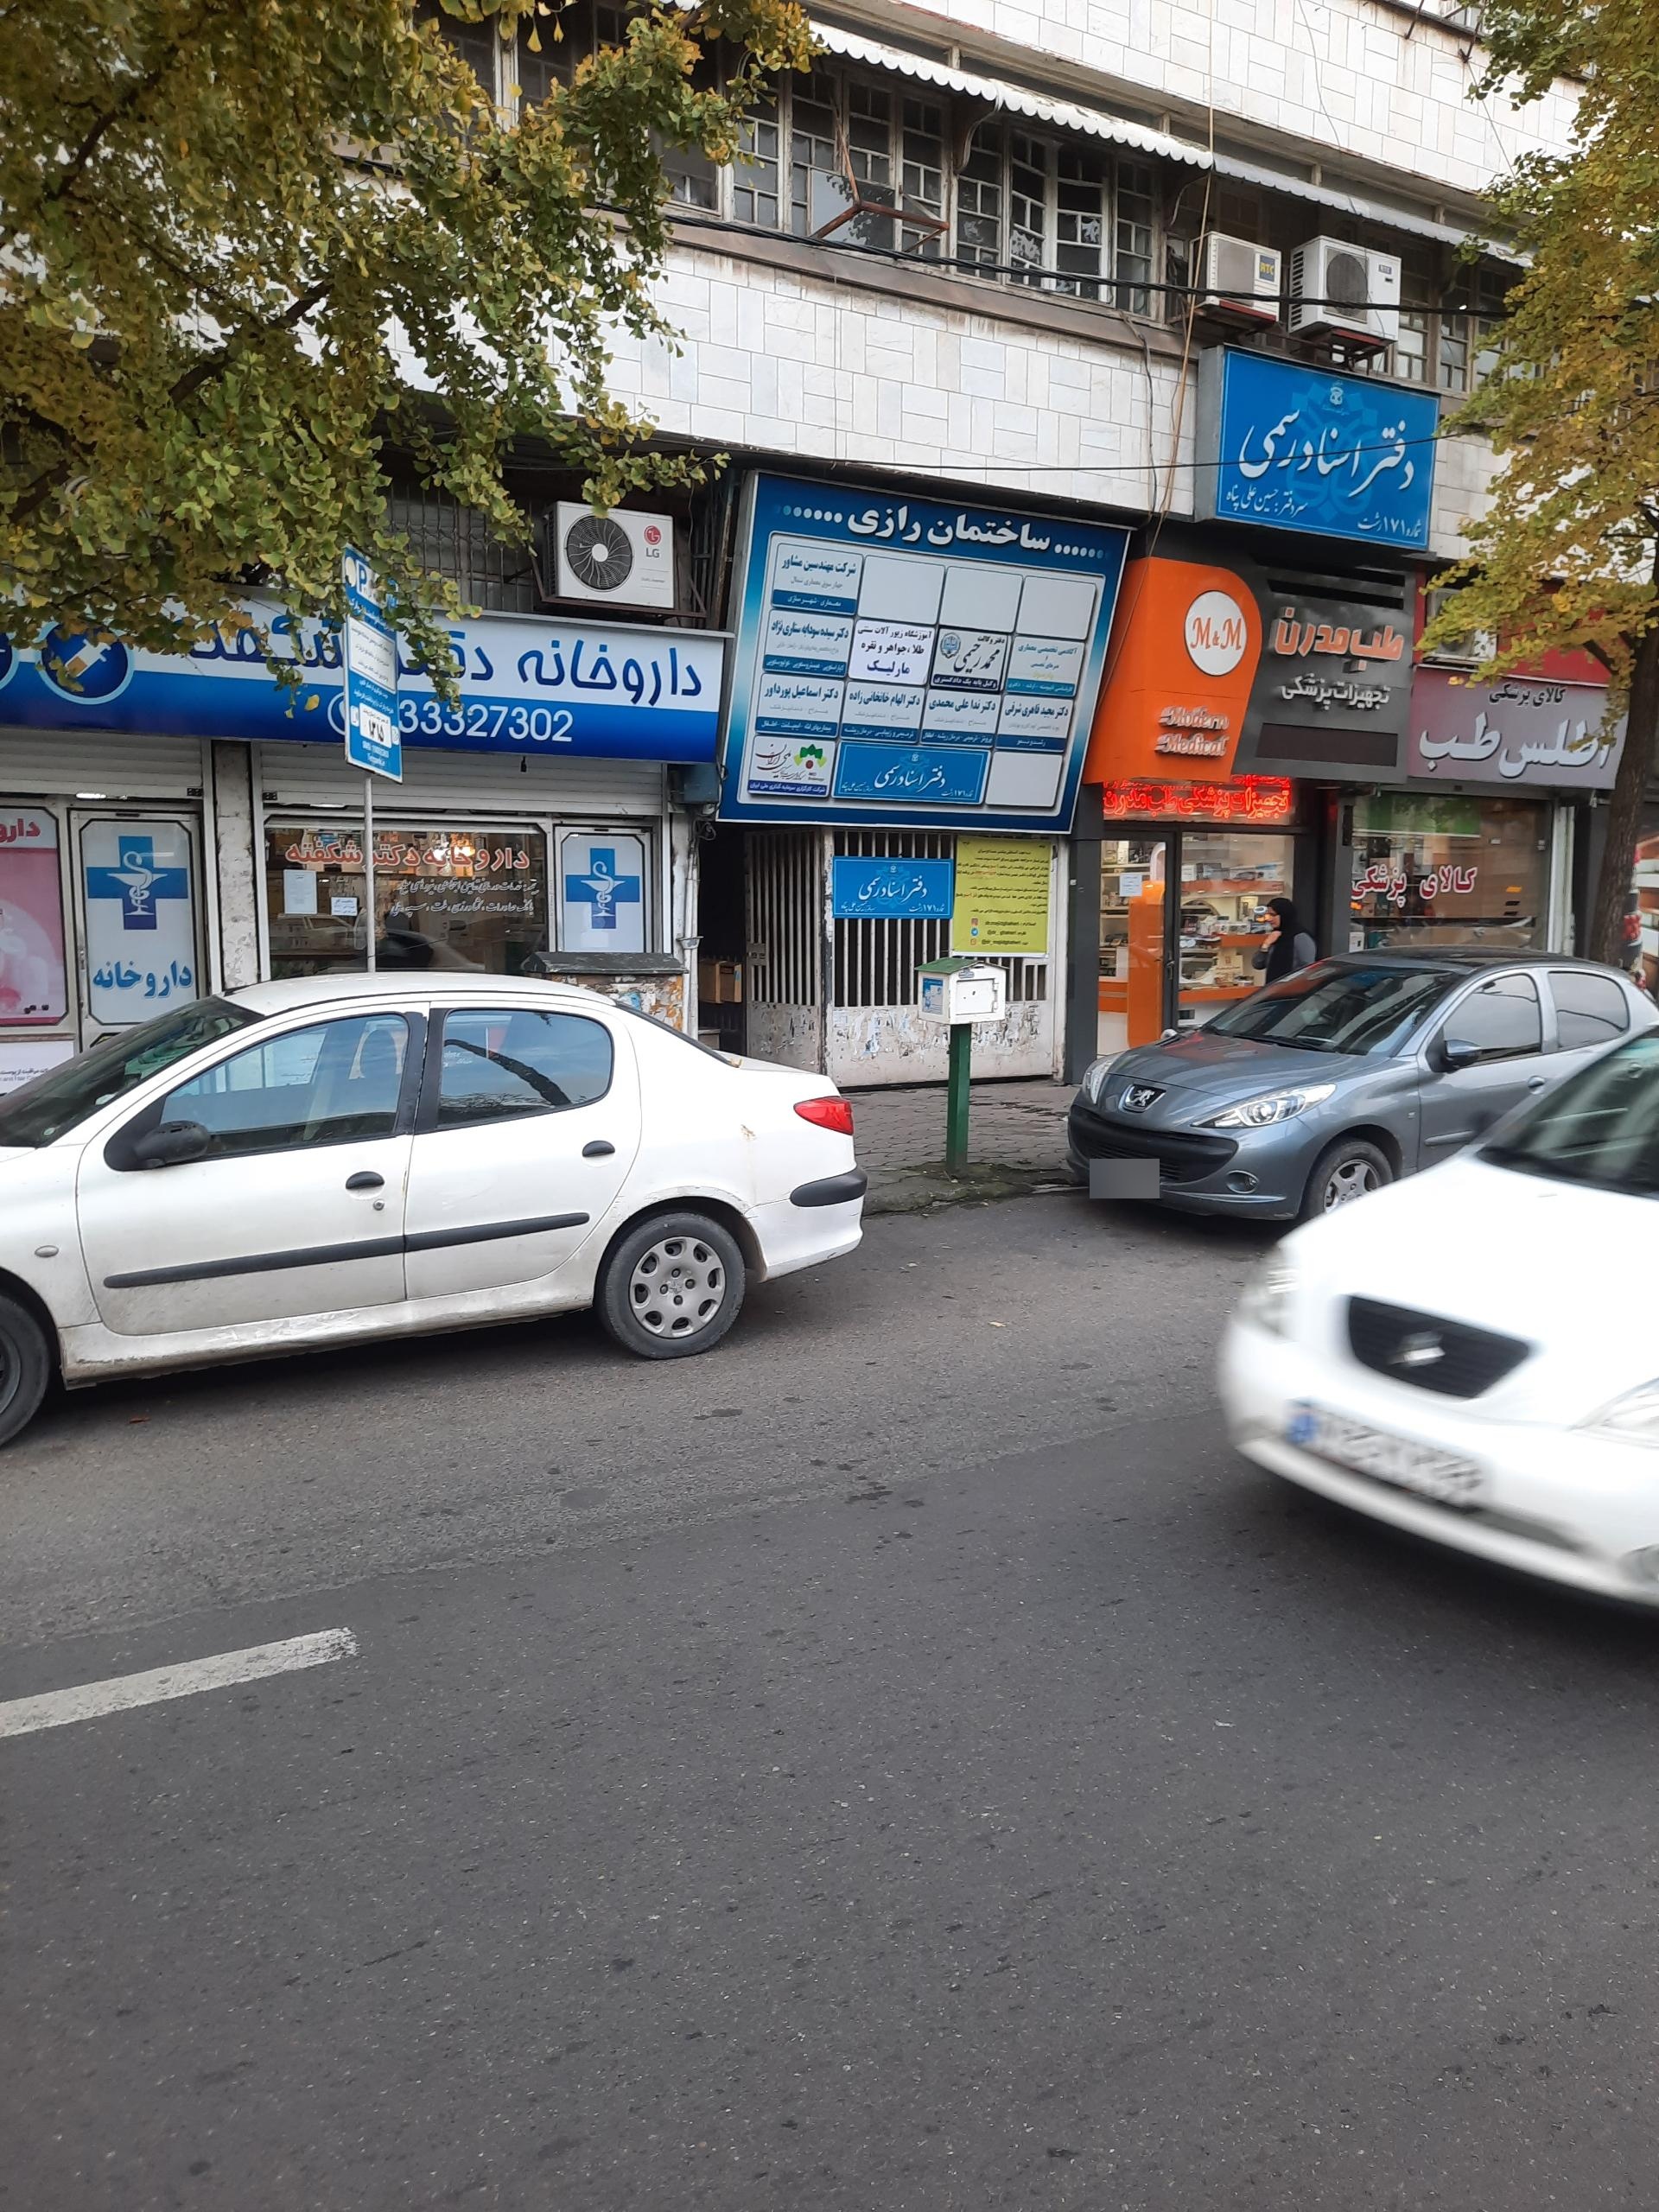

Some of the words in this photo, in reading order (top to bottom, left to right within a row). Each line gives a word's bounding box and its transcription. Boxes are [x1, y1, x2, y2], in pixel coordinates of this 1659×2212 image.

[1239, 409, 1300, 478] رسمی
[1298, 427, 1362, 479] اسناد
[1349, 420, 1414, 497] دفتر
[848, 505, 922, 543] رازی
[927, 512, 1051, 551] ساختمان
[645, 547, 659, 559] LG
[781, 554, 803, 569] مشاور
[804, 560, 834, 574] مهندسین
[836, 561, 857, 577] شرکت
[772, 619, 784, 635] نژاد
[783, 621, 802, 637] ستاری
[802, 623, 820, 639] سودابه
[819, 627, 834, 640] سیده
[833, 626, 849, 642] دکتر
[874, 626, 890, 636] آلات
[890, 631, 904, 639] زیور
[904, 629, 932, 642] آموزشگاه
[1274, 607, 1350, 658] مدرن
[861, 640, 877, 652] نقره
[878, 645, 883, 654] و
[912, 644, 925, 654] طلا
[1350, 625, 1405, 672] طب
[867, 659, 912, 678] مارلیک
[953, 644, 982, 674] رحیمی
[979, 649, 1001, 671] محمد
[516, 639, 702, 706] داروخانه
[934, 676, 963, 684] دادگستری
[791, 683, 822, 698] اسماعیل
[821, 688, 839, 702] دکتر
[849, 690, 863, 705] زاده
[890, 692, 906, 707] الهام
[1281, 673, 1333, 710] پزشکی
[1332, 680, 1391, 709] تجهیزات
[1488, 683, 1532, 707] پزشکی
[1532, 687, 1567, 708] کالای
[906, 695, 921, 709] دکتر
[929, 699, 955, 711] محمدی
[955, 698, 969, 712] علی
[970, 699, 981, 709] ندا
[979, 701, 996, 715] دکتر
[1040, 706, 1055, 718] مجید
[1054, 705, 1069, 720] دکتر
[1158, 705, 1230, 731] Modern
[1154, 733, 1230, 758] Medical
[1419, 710, 1502, 772] طب
[1498, 718, 1612, 779] اطلس
[874, 764, 900, 789] رسمی
[896, 770, 925, 787] اسناد
[917, 765, 946, 793] دفتر
[1102, 788, 1148, 817] مدرن
[1146, 783, 1180, 818] طب
[1178, 785, 1231, 819] پزشکی
[1230, 785, 1289, 820] تجهیزات
[285, 841, 364, 866] شکفته
[423, 847, 531, 872] داروخانه
[858, 876, 881, 900] رسمی
[879, 881, 906, 899] اسناد
[899, 874, 928, 905] دفتر
[1351, 862, 1408, 908] پزشکی
[1420, 863, 1478, 900] کالای
[92, 960, 193, 999] داروخانه
